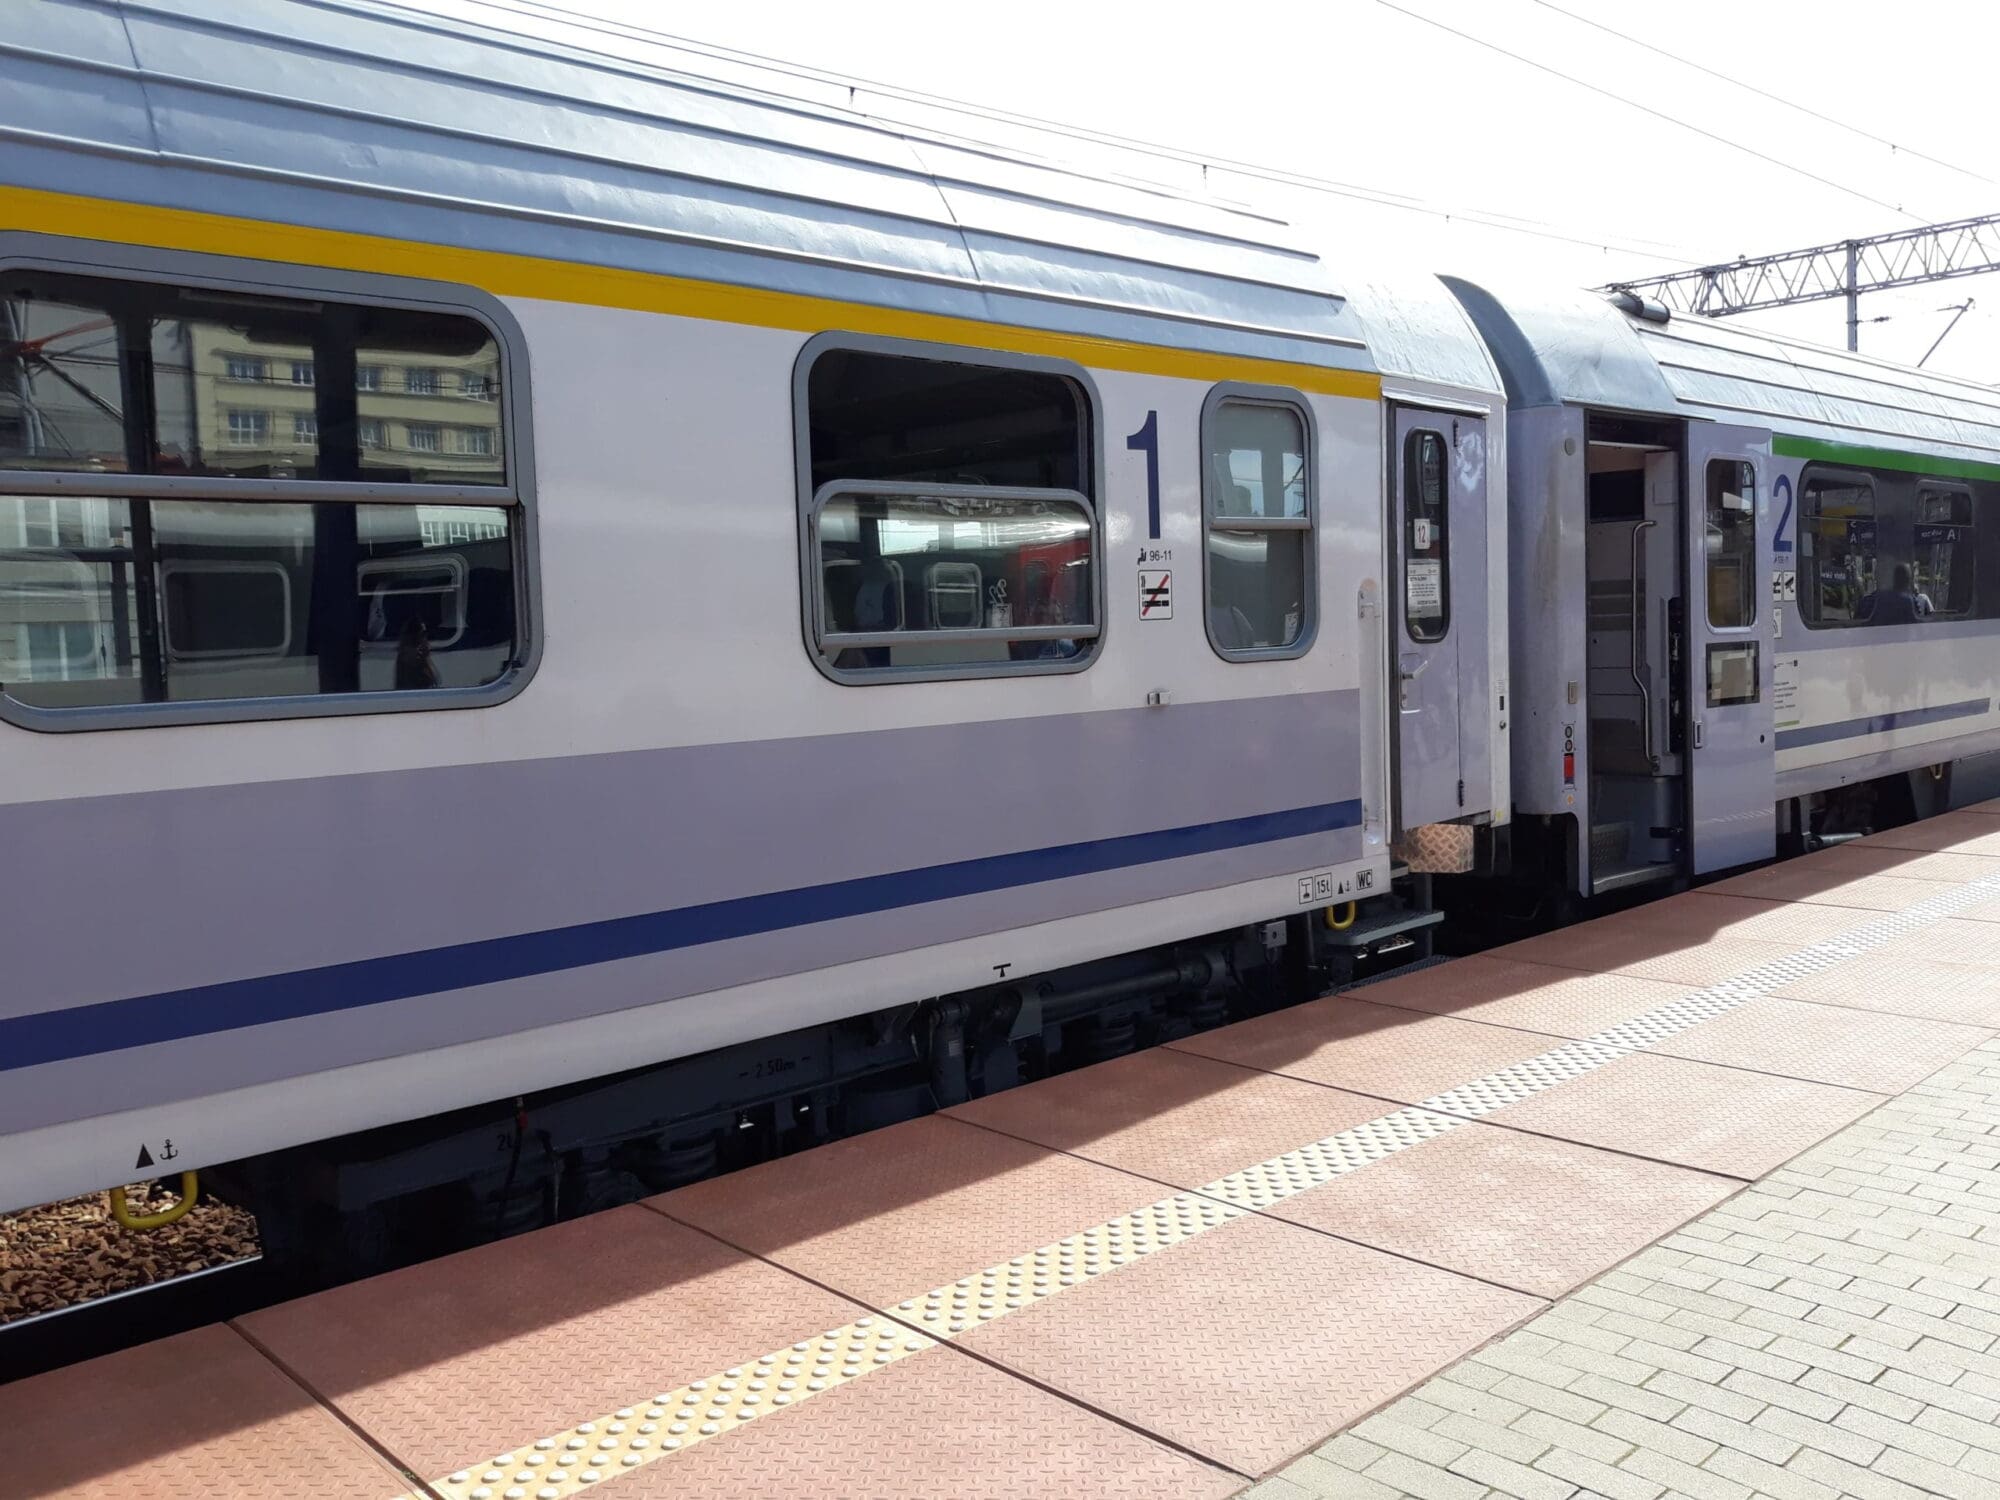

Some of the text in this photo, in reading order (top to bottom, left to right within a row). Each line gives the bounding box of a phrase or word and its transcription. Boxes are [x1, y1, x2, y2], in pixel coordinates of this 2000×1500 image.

[1127, 410, 1160, 539] 1
[1773, 474, 1792, 552] 2
[1417, 525, 1426, 543] 12
[1149, 550, 1172, 562] 96-11
[1358, 871, 1372, 889] WC
